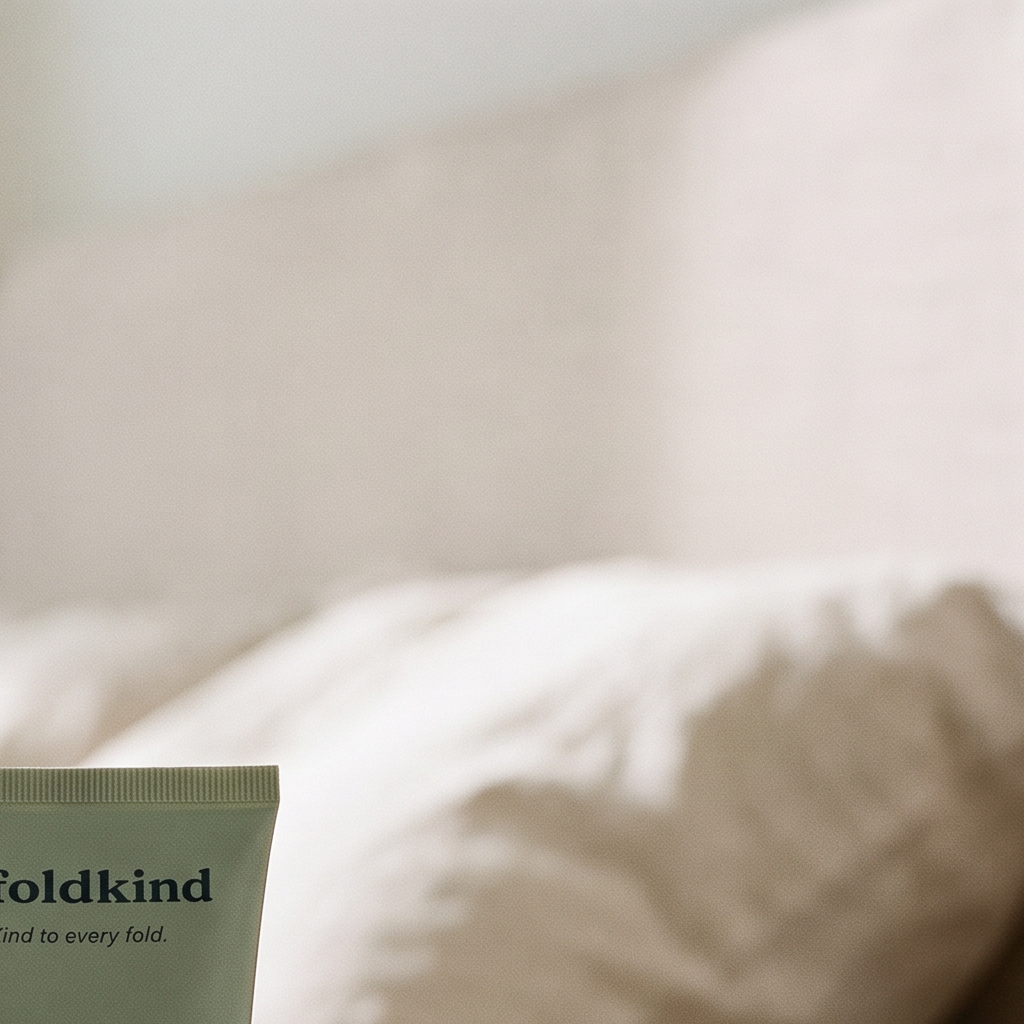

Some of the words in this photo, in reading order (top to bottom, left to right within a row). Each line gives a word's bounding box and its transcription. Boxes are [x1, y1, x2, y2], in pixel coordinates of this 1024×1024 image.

[39, 928, 60, 944] to
[64, 930, 121, 949] every
[125, 925, 167, 944] fold.
